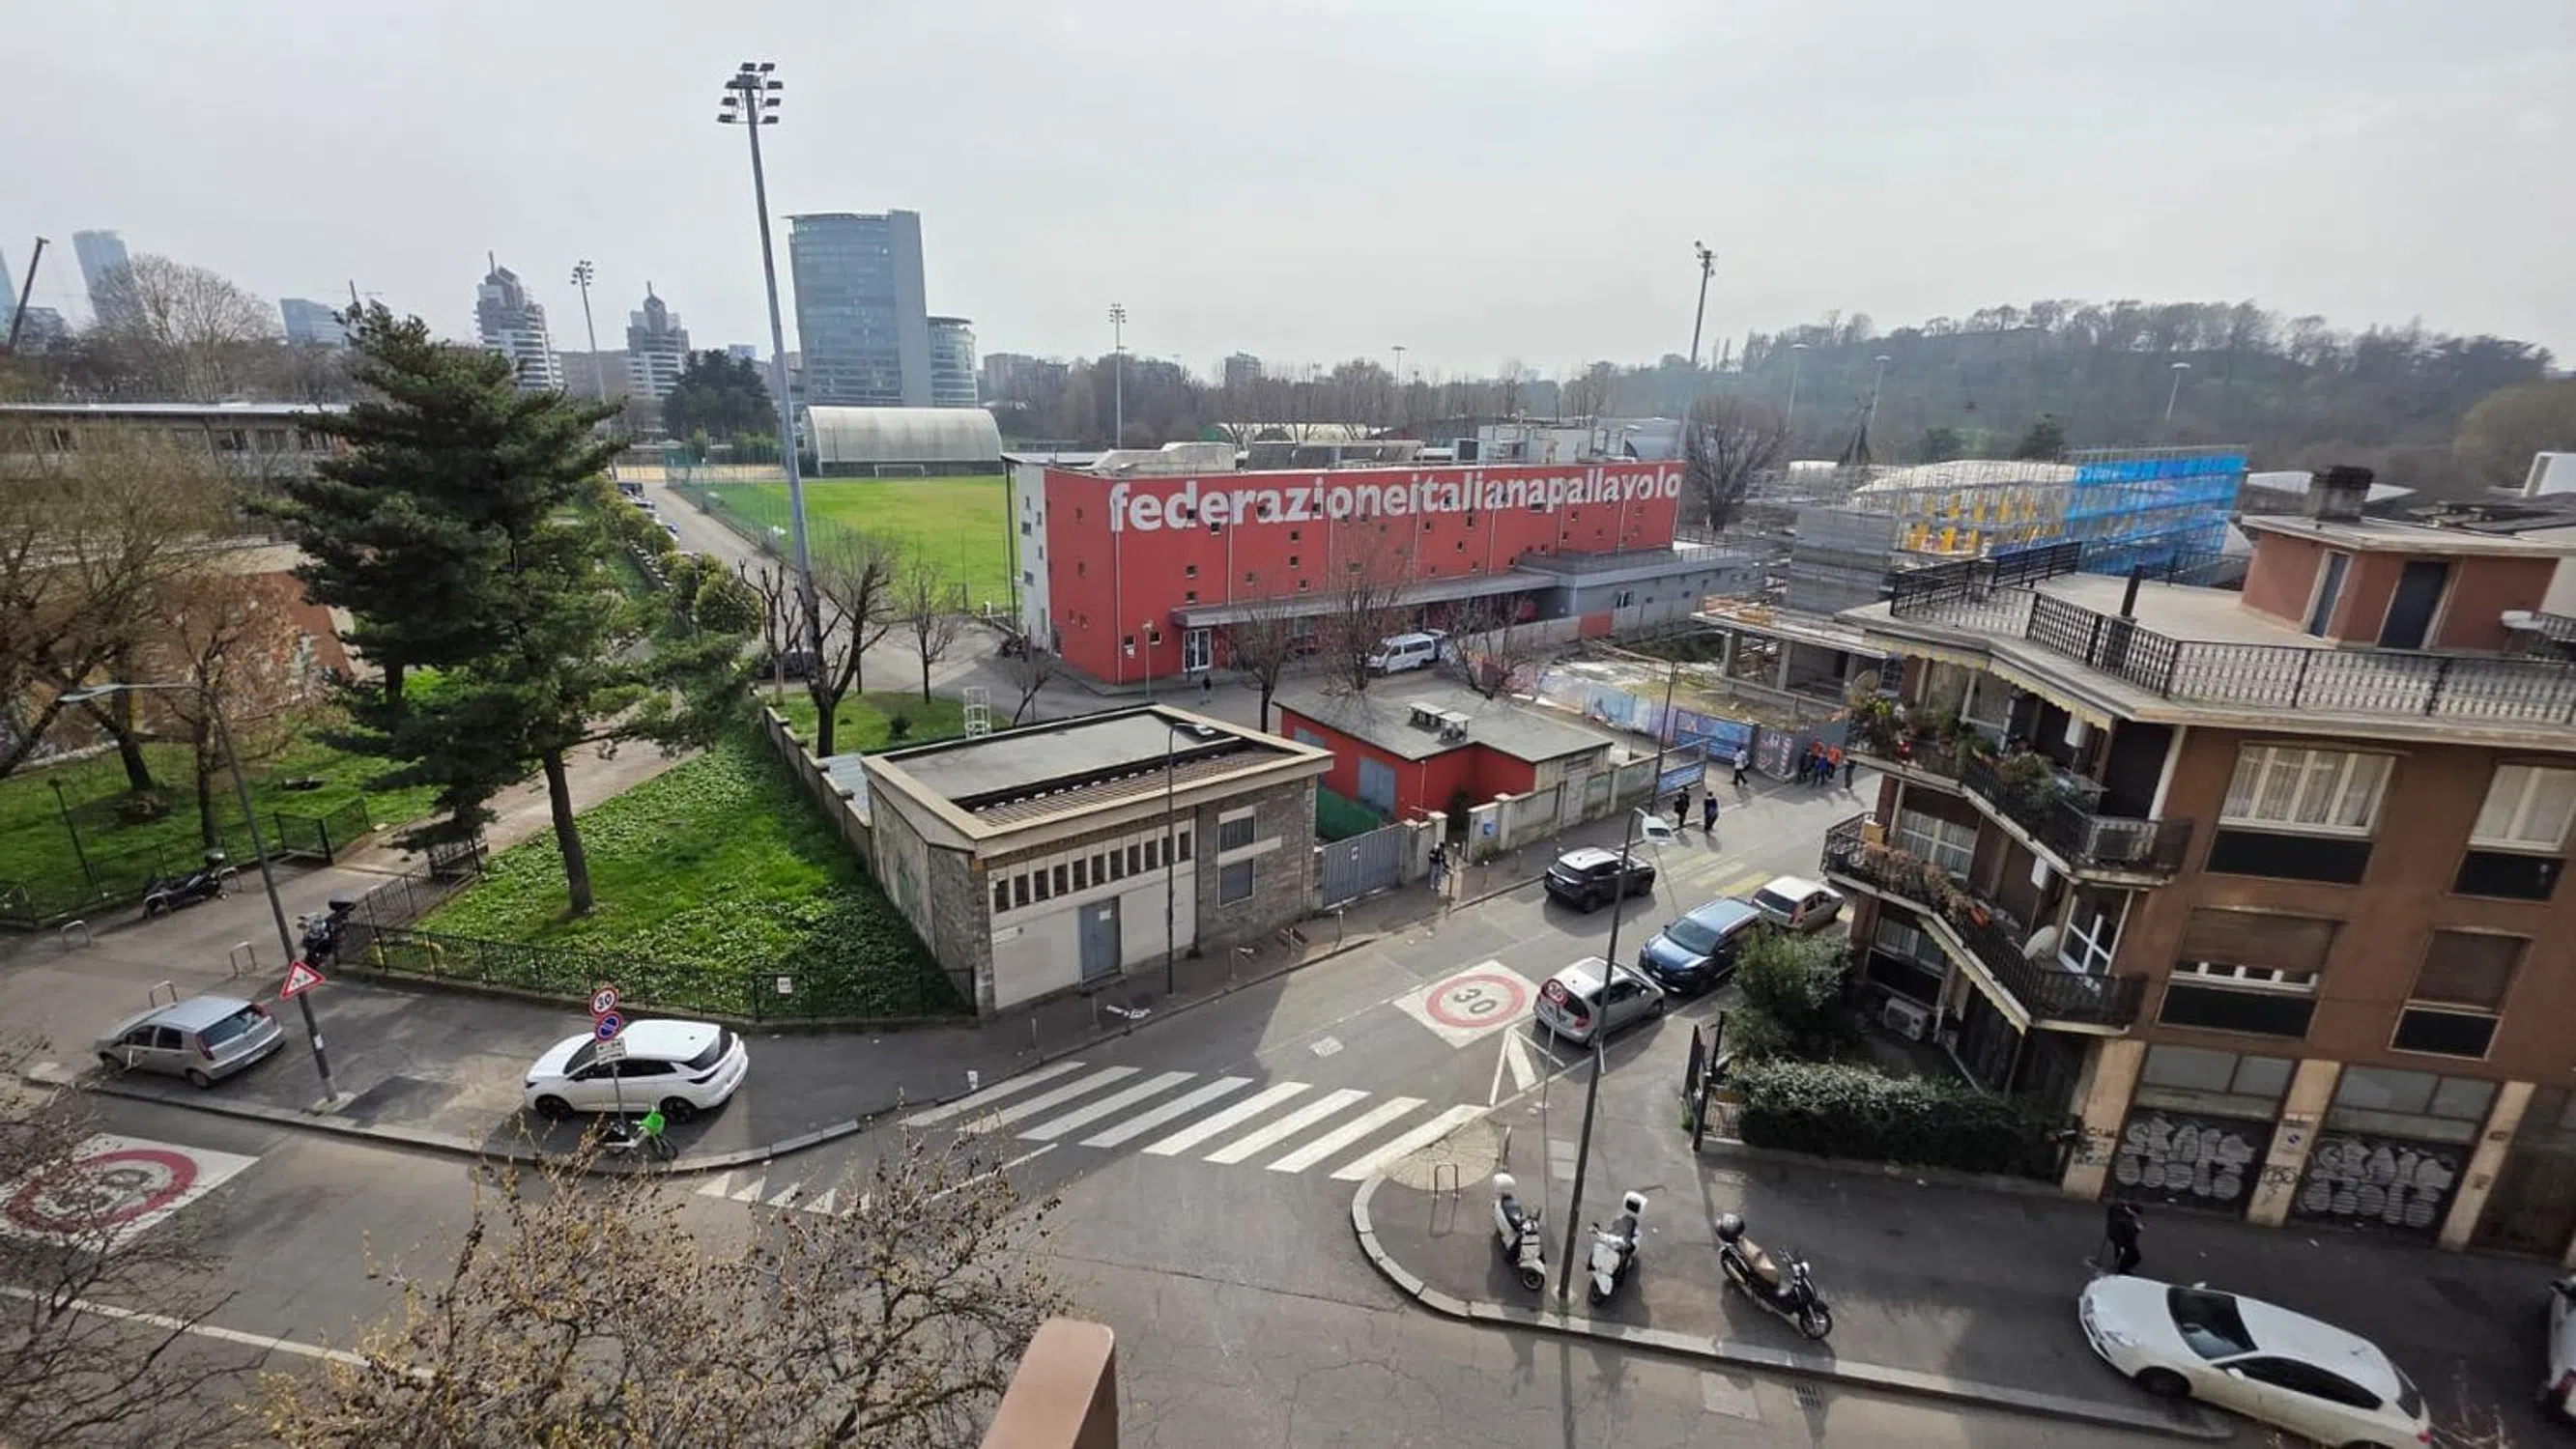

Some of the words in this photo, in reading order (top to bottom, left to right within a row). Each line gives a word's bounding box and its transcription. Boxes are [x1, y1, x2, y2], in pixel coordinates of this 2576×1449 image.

[1109, 466, 1682, 532] federazioneitalianapallavolo
[597, 993, 613, 1010] 30
[1453, 988, 1498, 1014] 30
